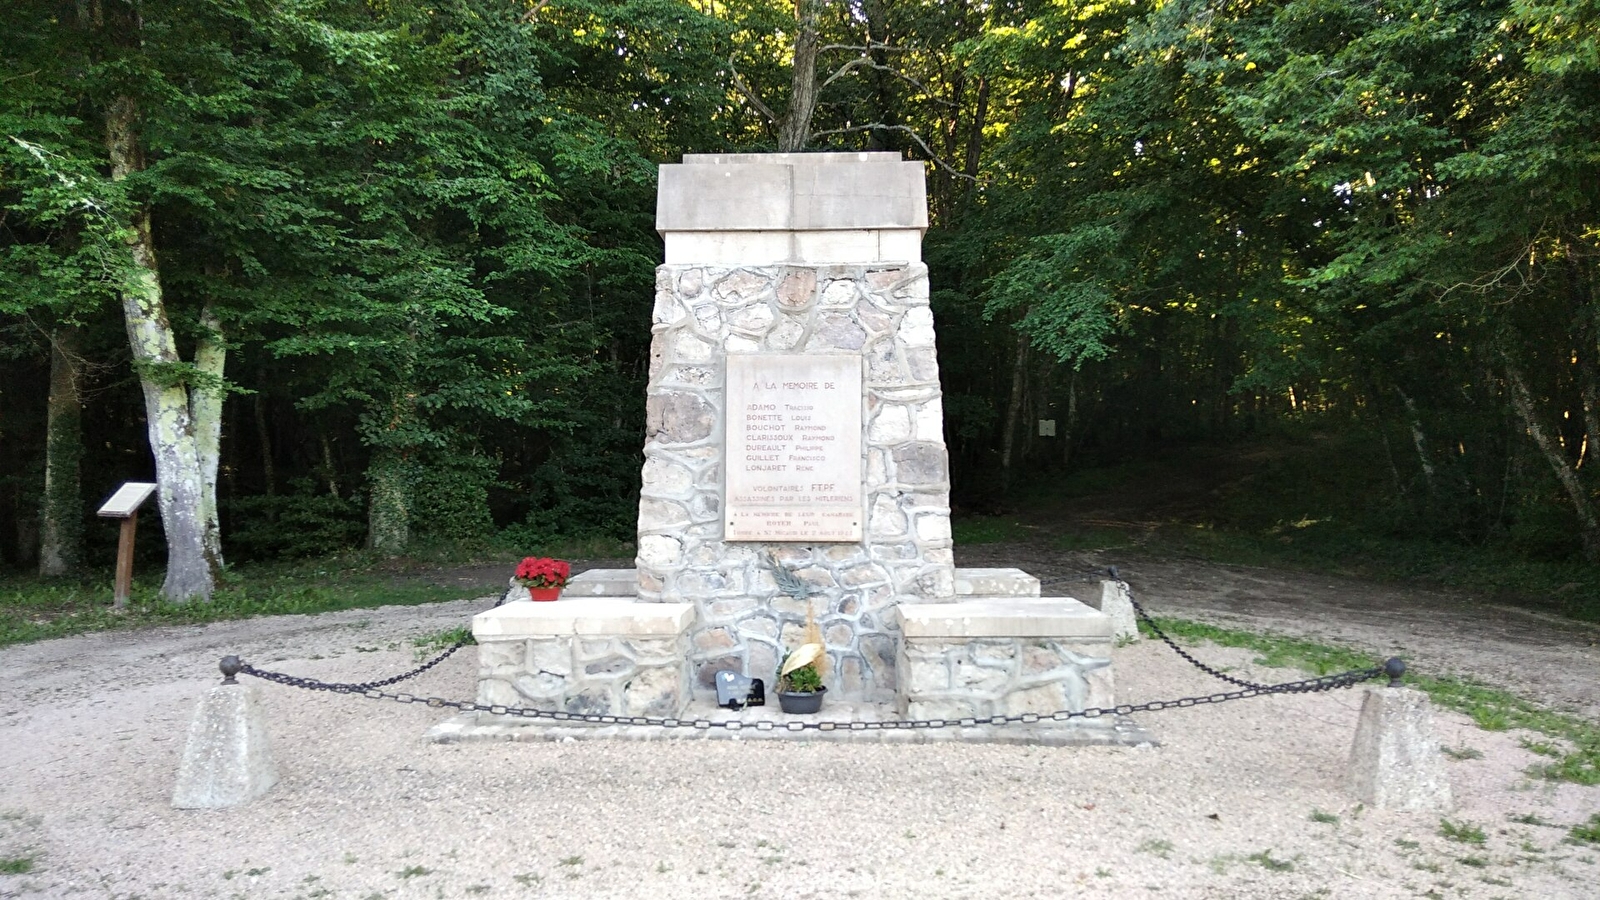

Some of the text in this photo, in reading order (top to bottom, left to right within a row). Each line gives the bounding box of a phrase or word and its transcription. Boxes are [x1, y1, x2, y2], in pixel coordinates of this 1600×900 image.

[765, 382, 777, 390] LA
[782, 382, 819, 390] MEMOIRE
[824, 382, 835, 390] DE
[745, 464, 787, 472] LONJARET
